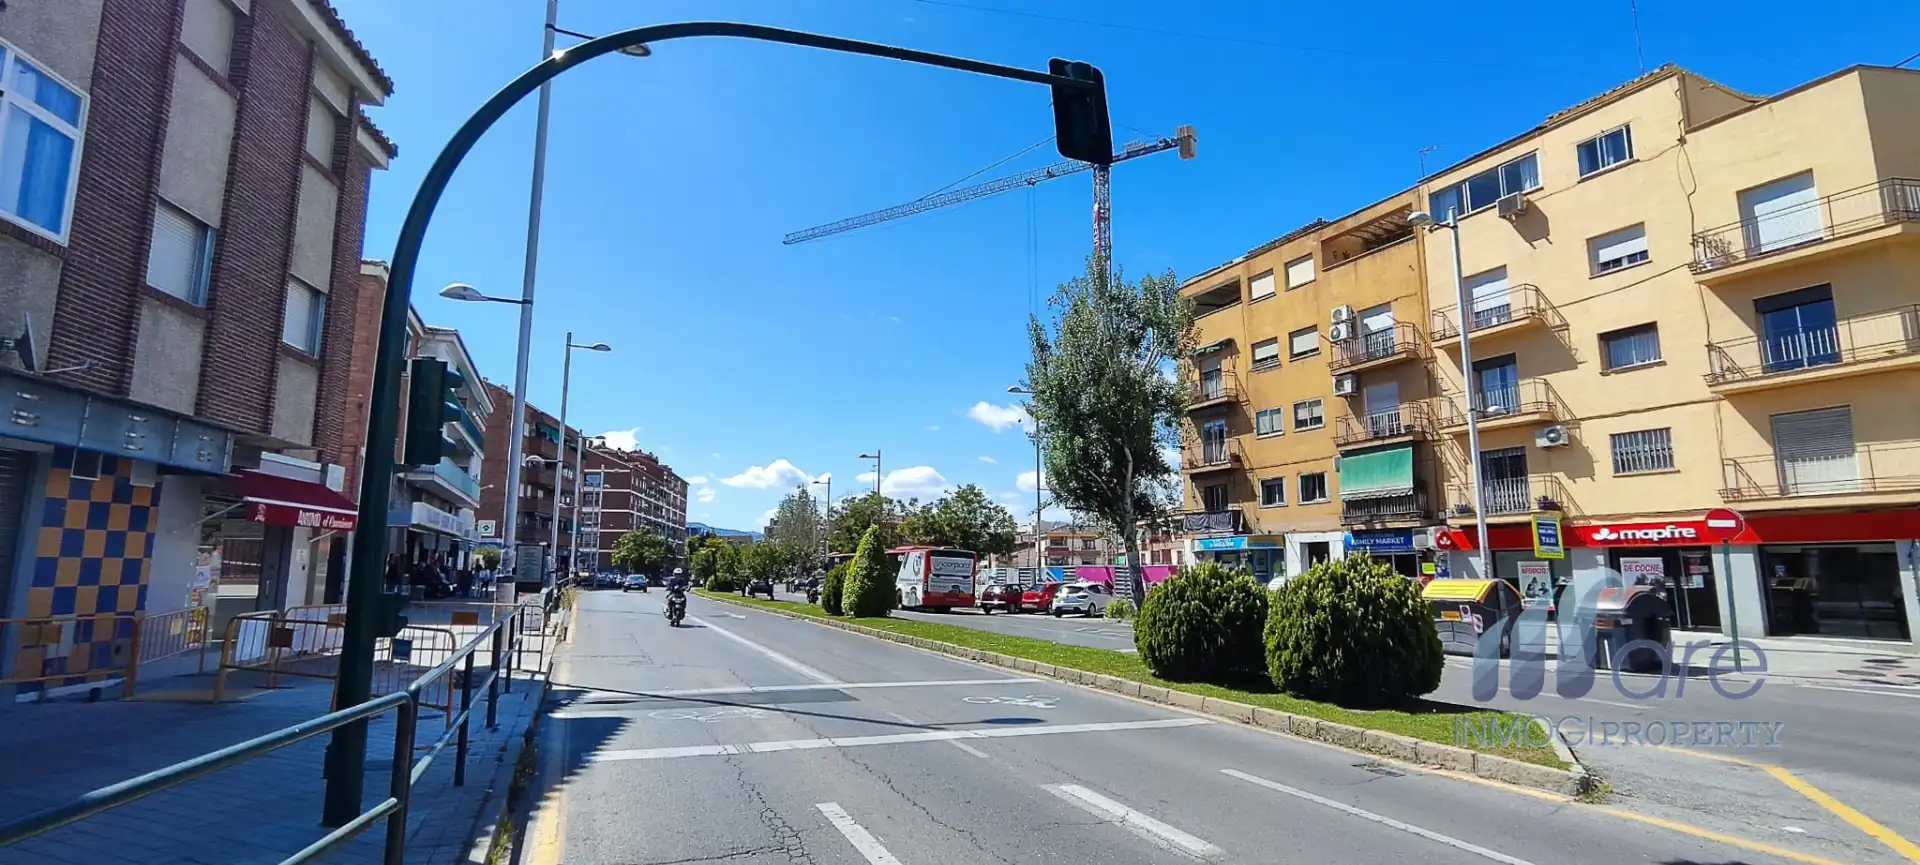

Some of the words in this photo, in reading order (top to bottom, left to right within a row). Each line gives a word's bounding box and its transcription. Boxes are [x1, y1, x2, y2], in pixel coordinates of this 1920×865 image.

[298, 510, 321, 527] ANTONIO
[1620, 525, 1697, 541] mapfre
[1375, 536, 1404, 545] MARKET
[1623, 564, 1635, 572] DE
[1635, 564, 1660, 573] COCHE
